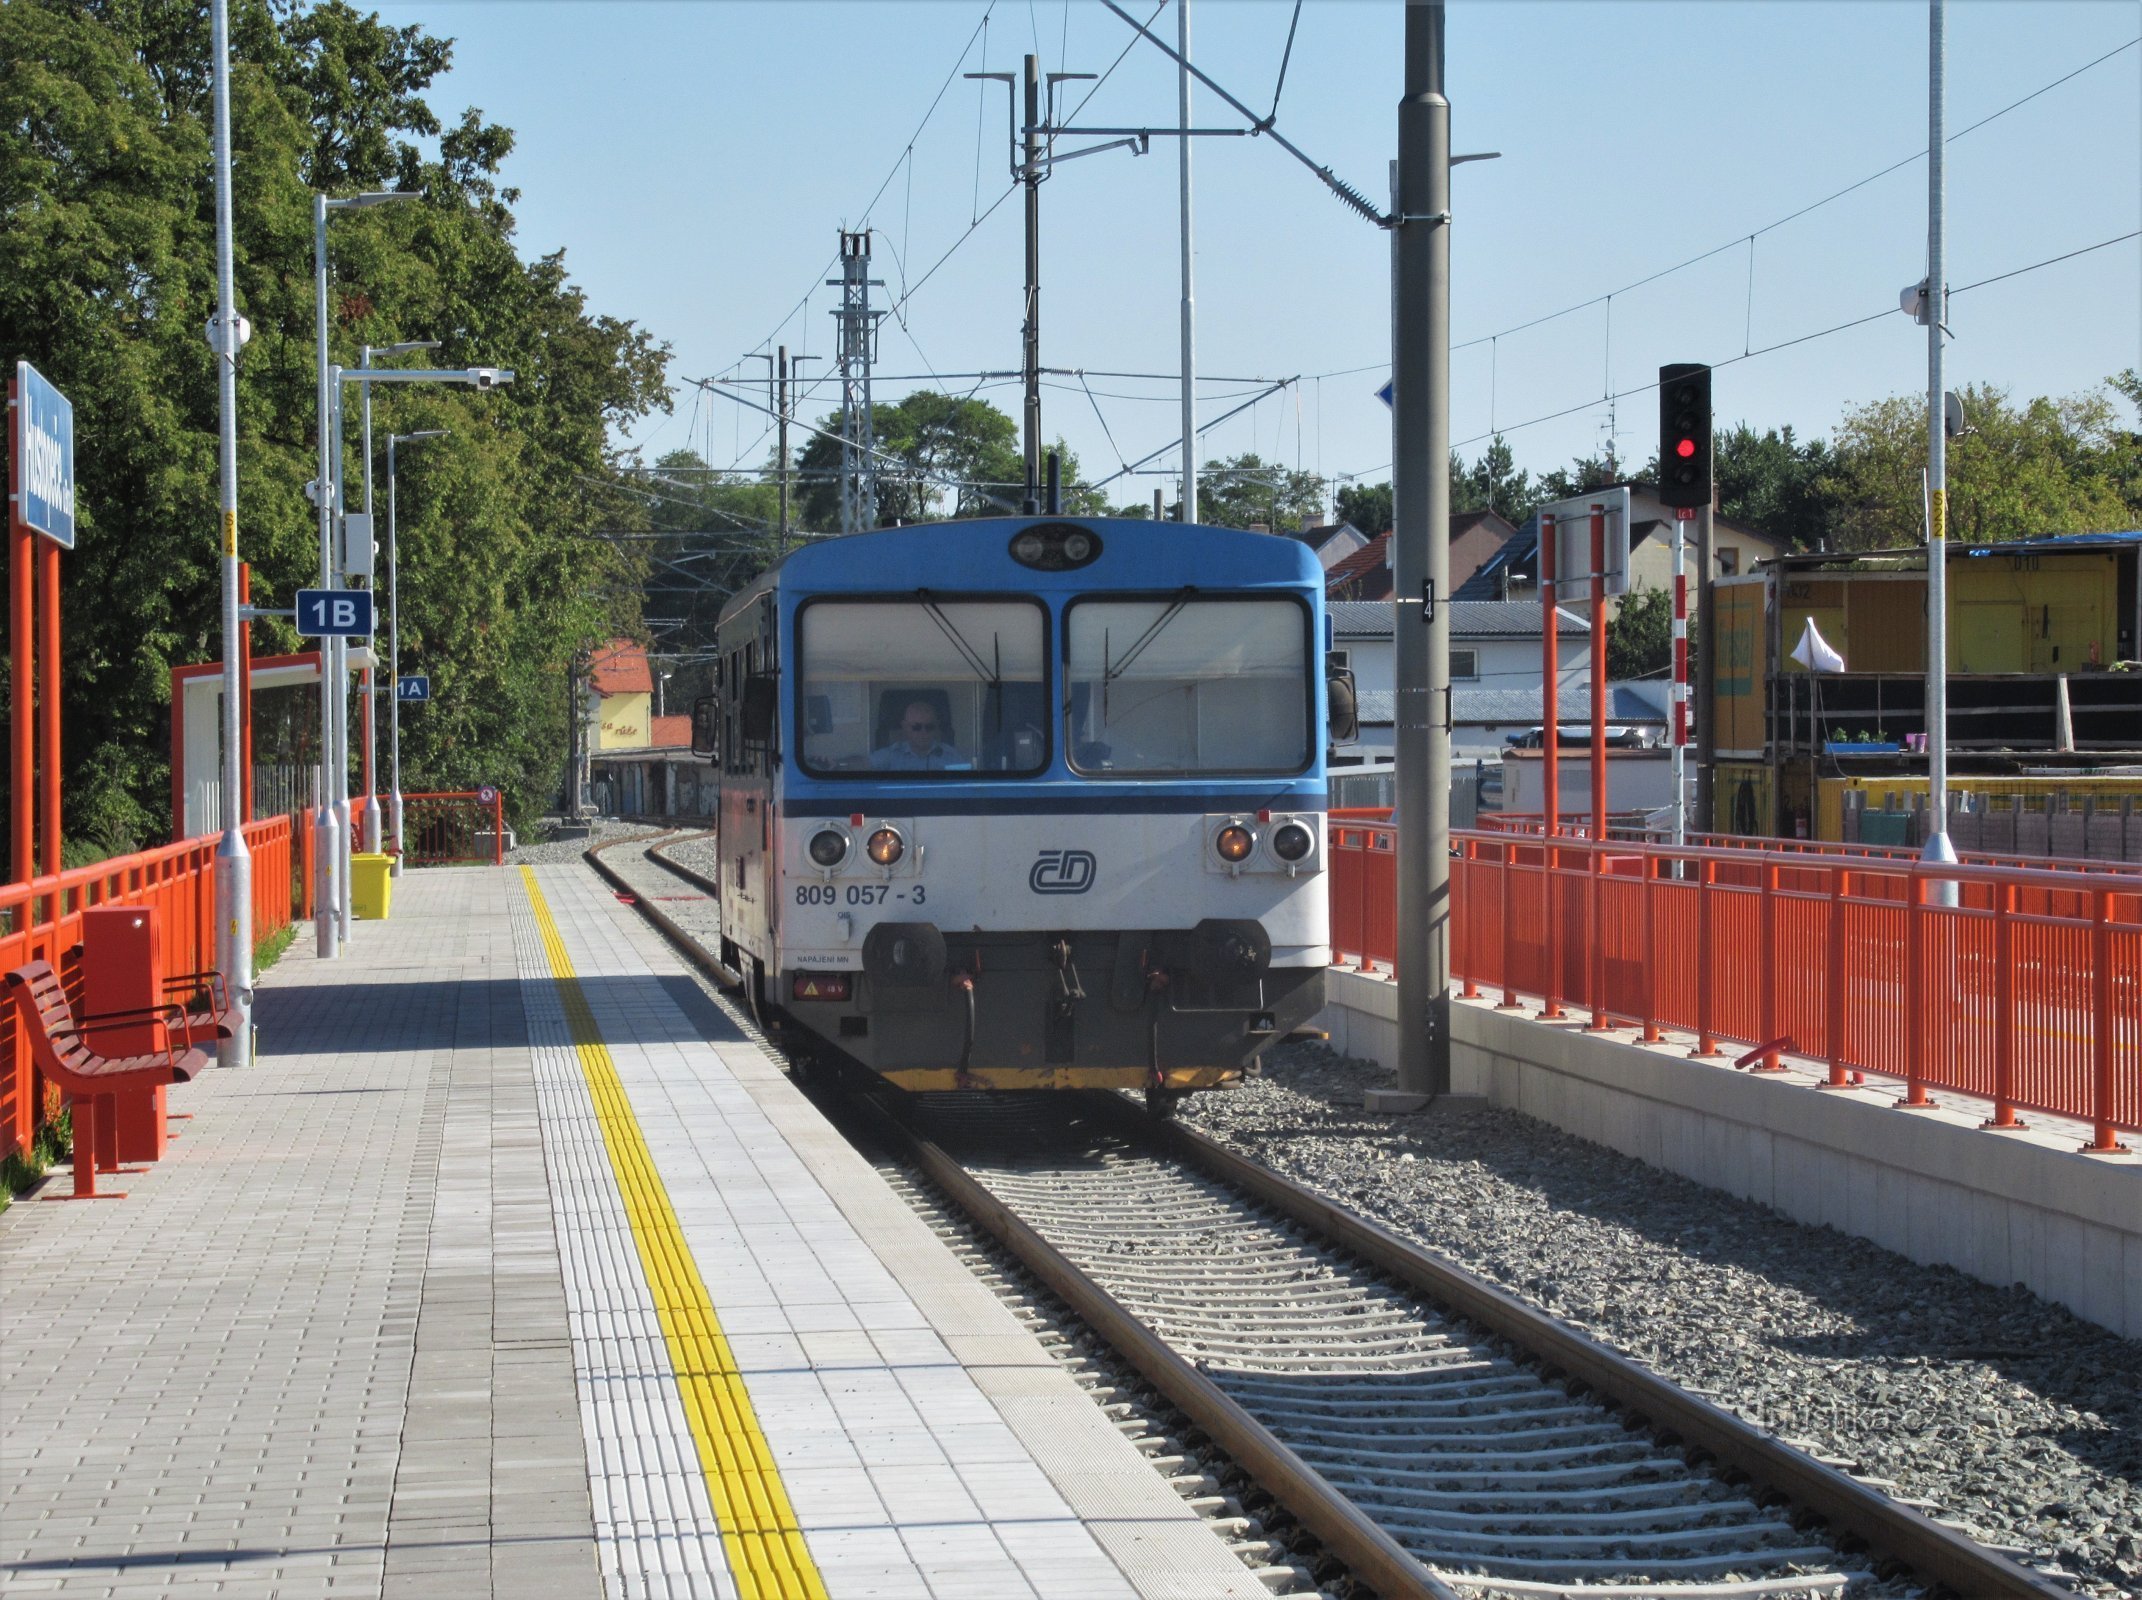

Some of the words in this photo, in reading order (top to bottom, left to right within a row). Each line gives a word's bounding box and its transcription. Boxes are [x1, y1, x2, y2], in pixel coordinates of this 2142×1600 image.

[1932, 491, 1943, 537] S22
[224, 513, 234, 555] S14
[312, 599, 356, 627] 1B
[1424, 583, 1433, 619] 14
[397, 681, 422, 696] 1A
[796, 885, 836, 905] 809
[846, 885, 890, 905] 057
[912, 885, 926, 905] 3
